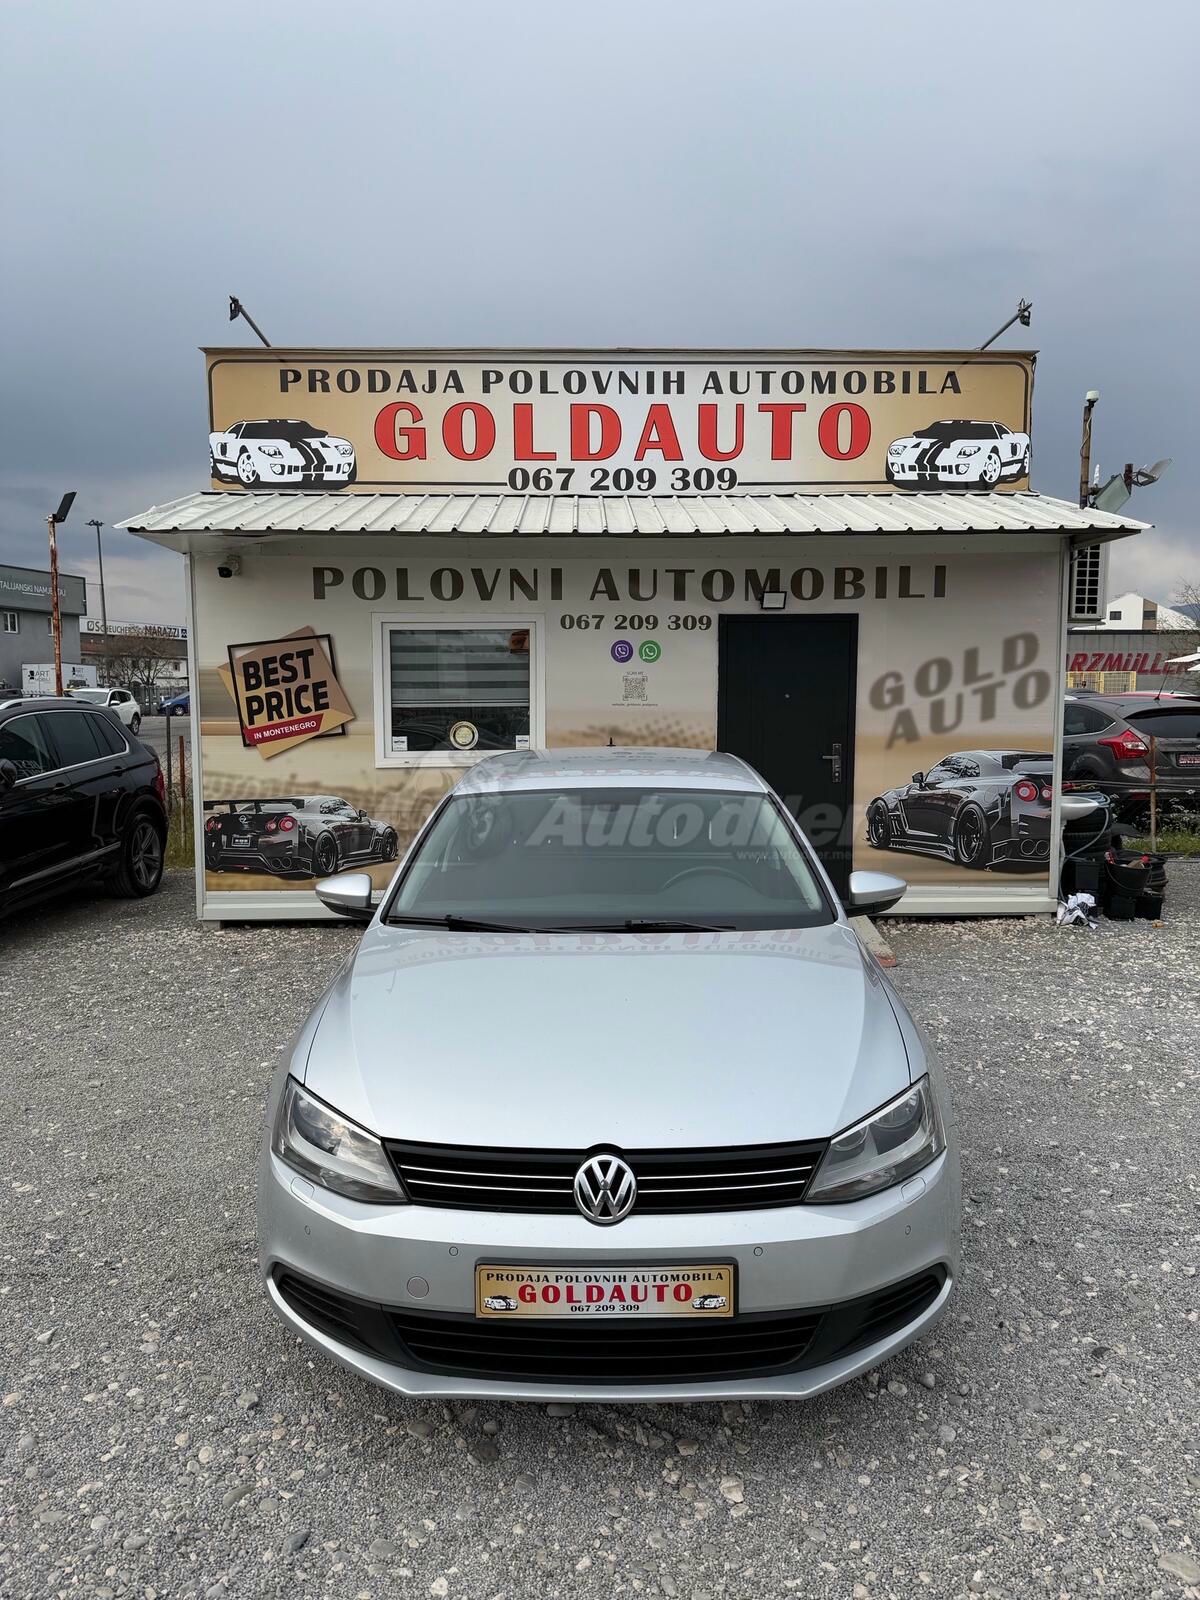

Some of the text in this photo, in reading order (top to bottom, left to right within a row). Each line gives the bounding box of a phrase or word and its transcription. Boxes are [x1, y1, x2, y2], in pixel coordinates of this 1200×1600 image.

[279, 368, 962, 395] PRODAJA POLOVNIH AUTOMOBILA
[374, 401, 872, 462] GOLDAUTO
[508, 467, 738, 491] 067 209 309
[312, 565, 947, 602] POLOVNI AUTOMOBILI
[560, 614, 712, 631] 067 209 309
[242, 648, 315, 692] BEST
[869, 631, 1040, 711] GOLD
[245, 680, 330, 726] PRICE
[886, 669, 1052, 750] AUTO
[254, 721, 317, 740] IN MONTENEGRO
[486, 1272, 724, 1284] PRODAJA POLOVNIH AUTOMOBILA
[518, 1283, 693, 1304] GOLDAUTO
[570, 1304, 640, 1312] 067 209 309
